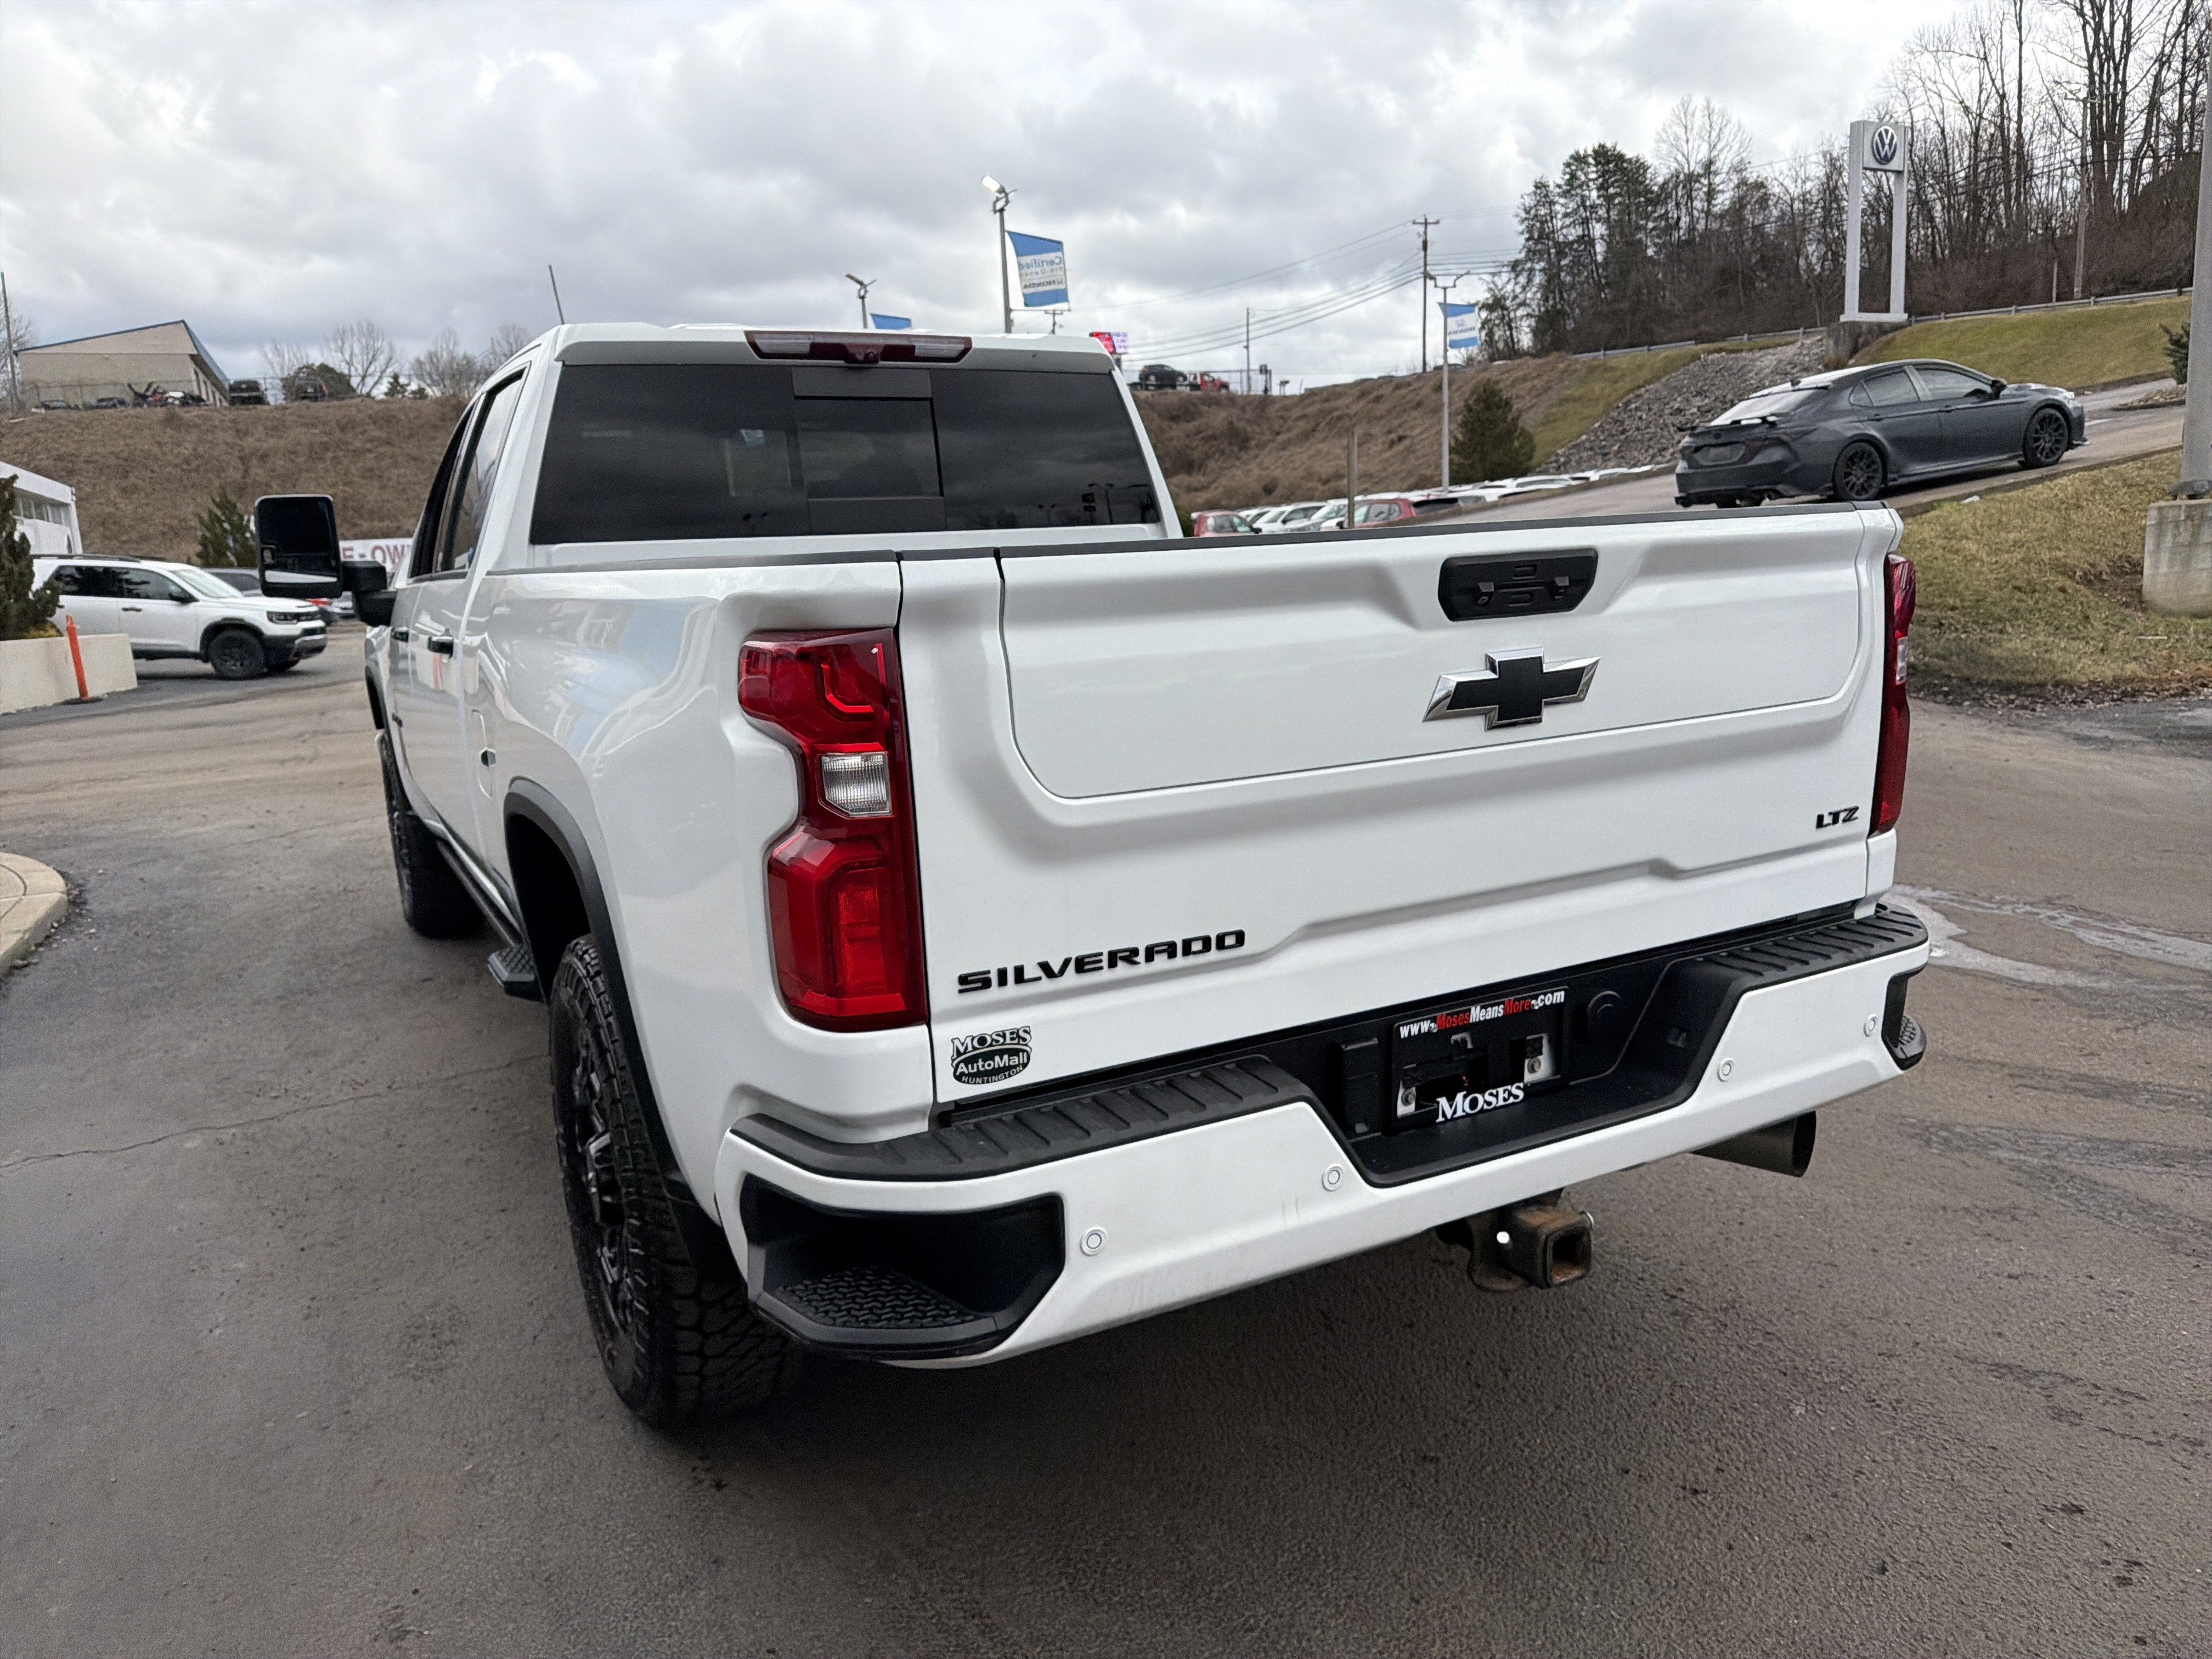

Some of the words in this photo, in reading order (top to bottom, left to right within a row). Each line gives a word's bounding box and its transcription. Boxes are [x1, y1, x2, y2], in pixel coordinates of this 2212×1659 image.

[1815, 805, 1859, 829] LTZ
[958, 929, 1245, 994] SILVERADO
[951, 1026, 1031, 1059] MOSES
[955, 1052, 1028, 1076] AutoMall
[961, 1065, 1023, 1084] HUNTINGTON
[1435, 1082, 1525, 1123] MOSES
